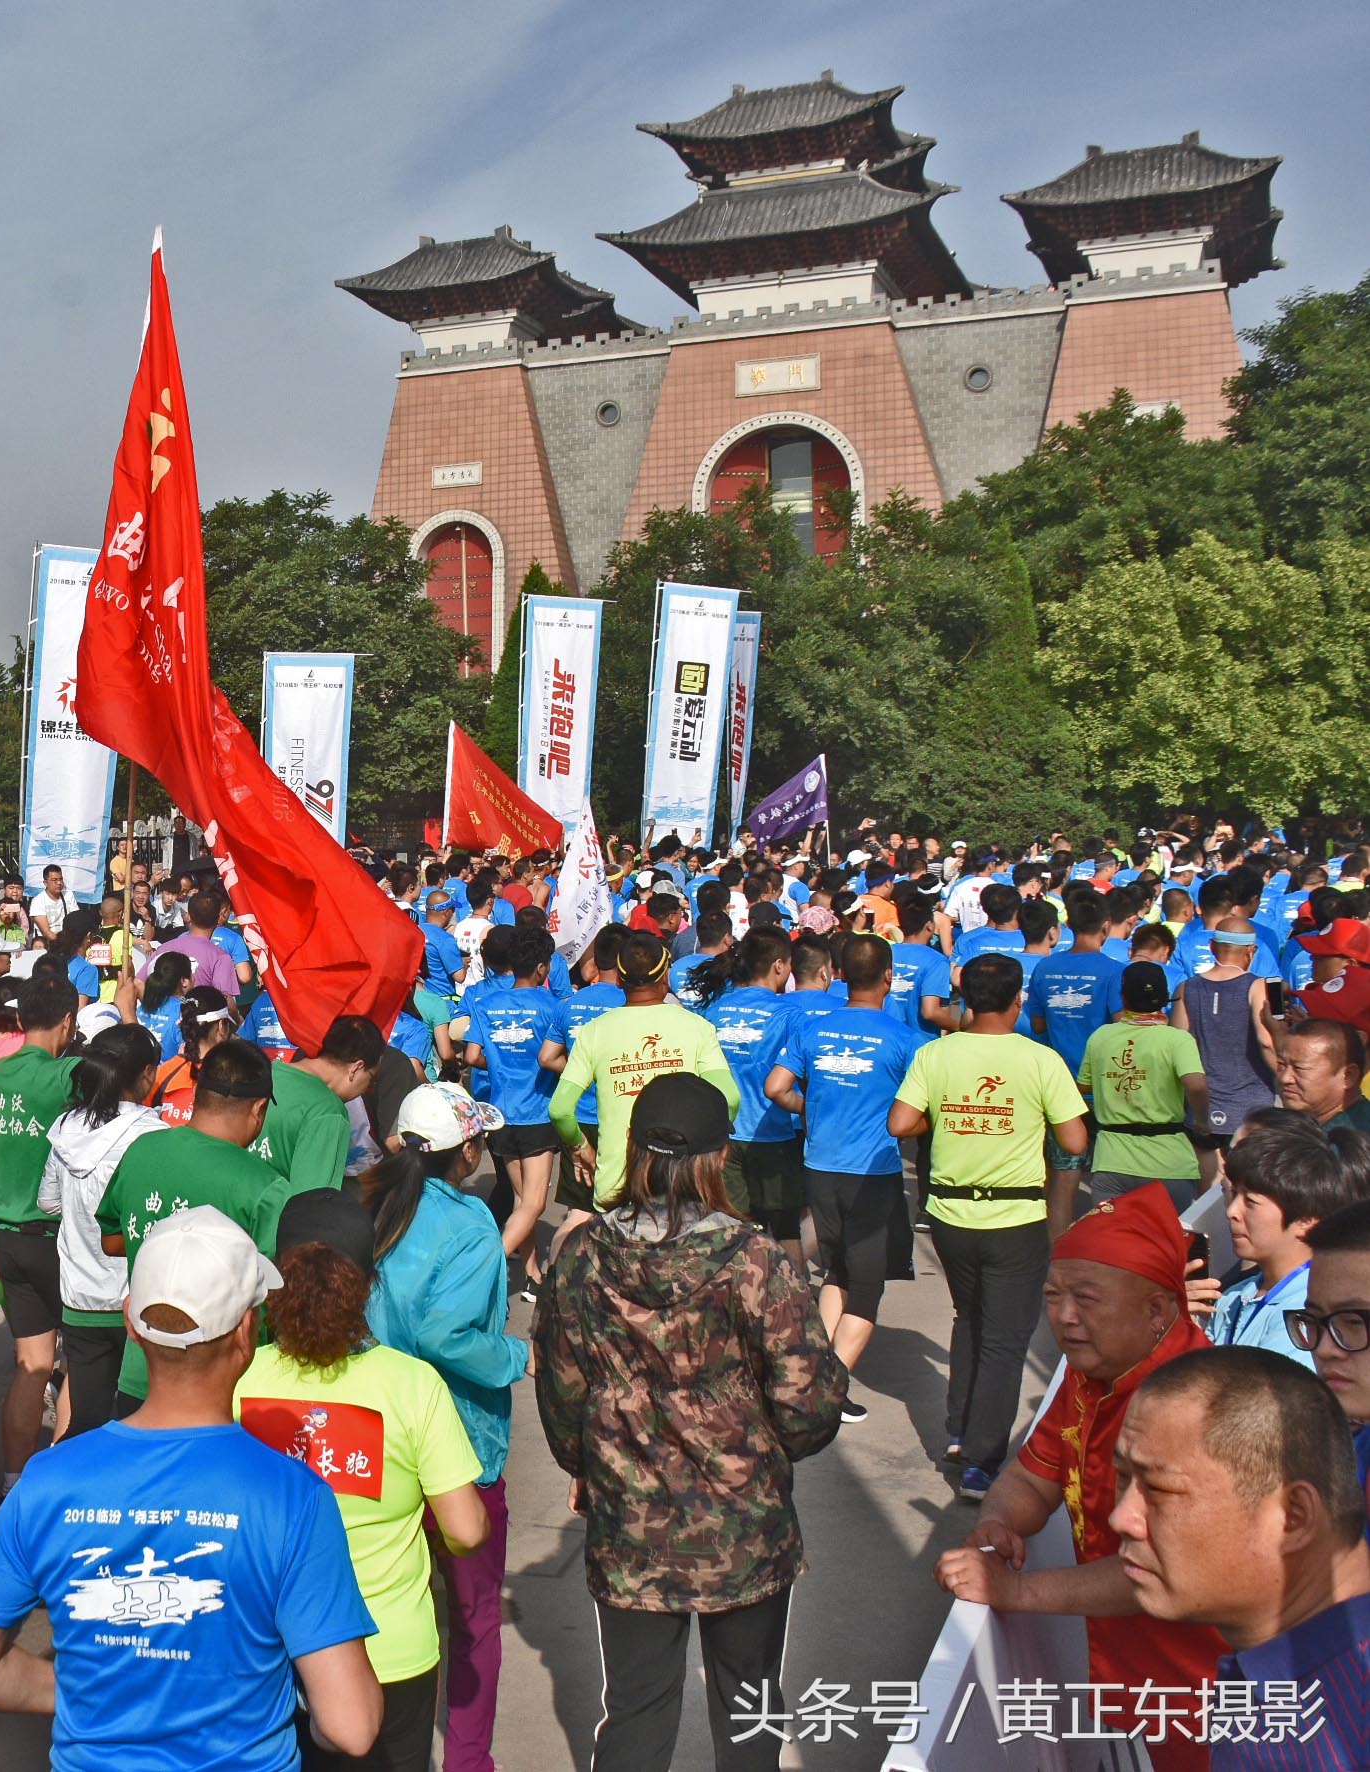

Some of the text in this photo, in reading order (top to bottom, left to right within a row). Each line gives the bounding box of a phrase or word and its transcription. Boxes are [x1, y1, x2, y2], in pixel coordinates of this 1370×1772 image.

[546, 657, 576, 780] 来跑吧
[40, 733, 72, 741] JINHUA
[289, 738, 305, 797] FITNESS
[943, 1116, 1013, 1134] 阳城长跑
[64, 1508, 239, 1530] 2018临汾“尧王杯”马拉松赛
